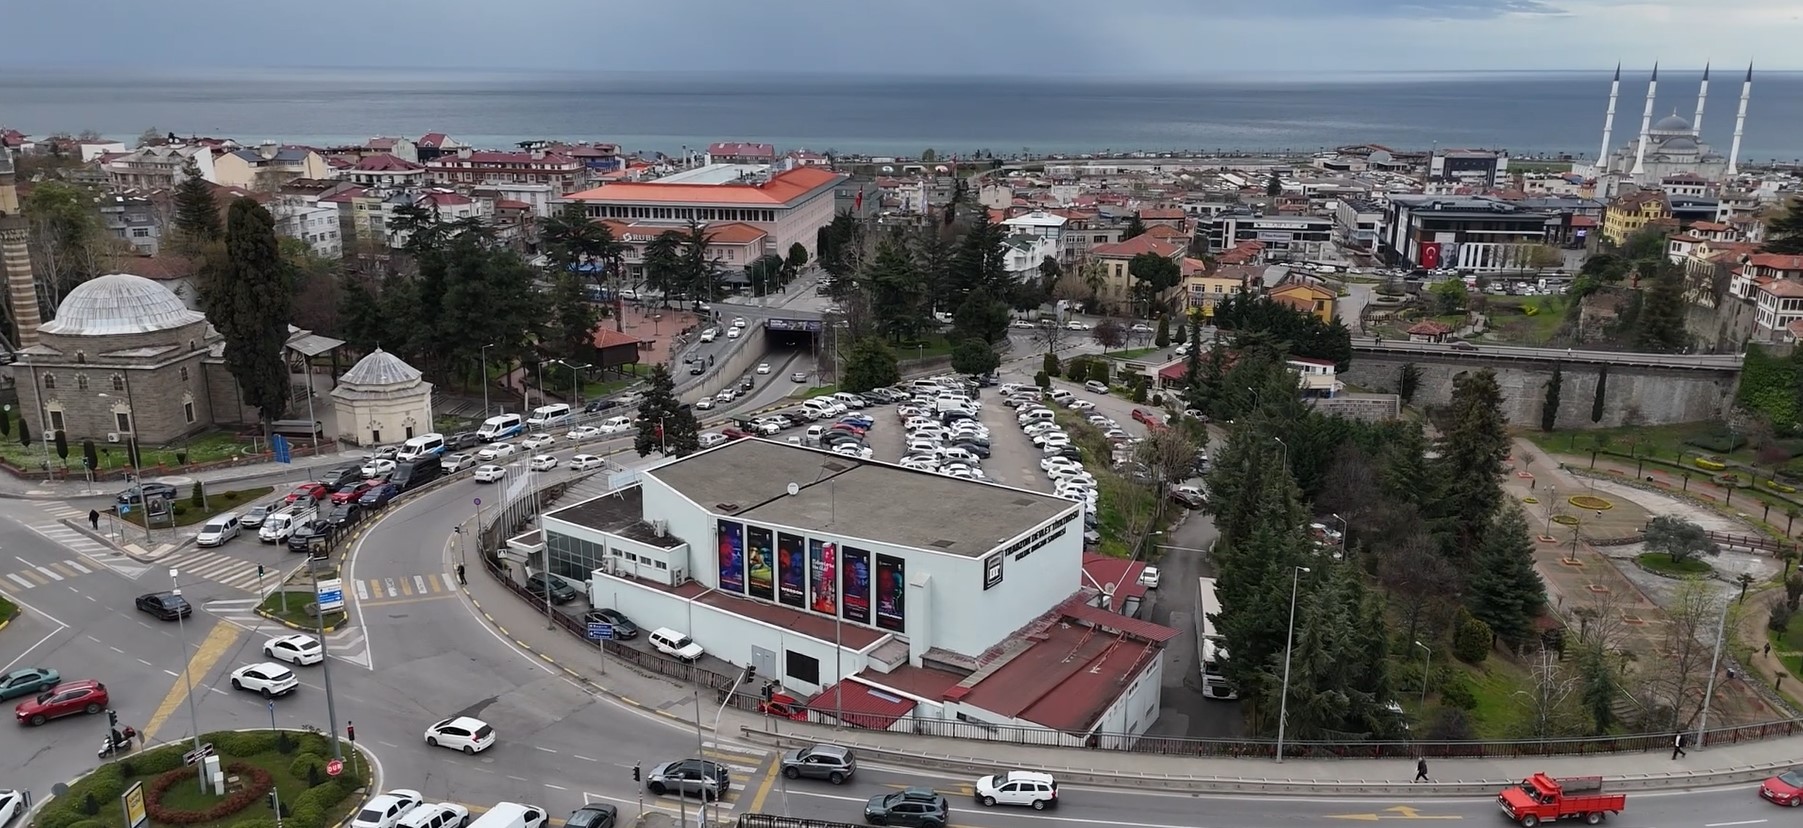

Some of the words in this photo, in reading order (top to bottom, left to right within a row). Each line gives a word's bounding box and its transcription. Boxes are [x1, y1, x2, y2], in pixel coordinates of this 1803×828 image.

[1005, 536, 1031, 557] TRABZON
[1031, 525, 1051, 542] DEVLET
[328, 764, 341, 772] DUR
